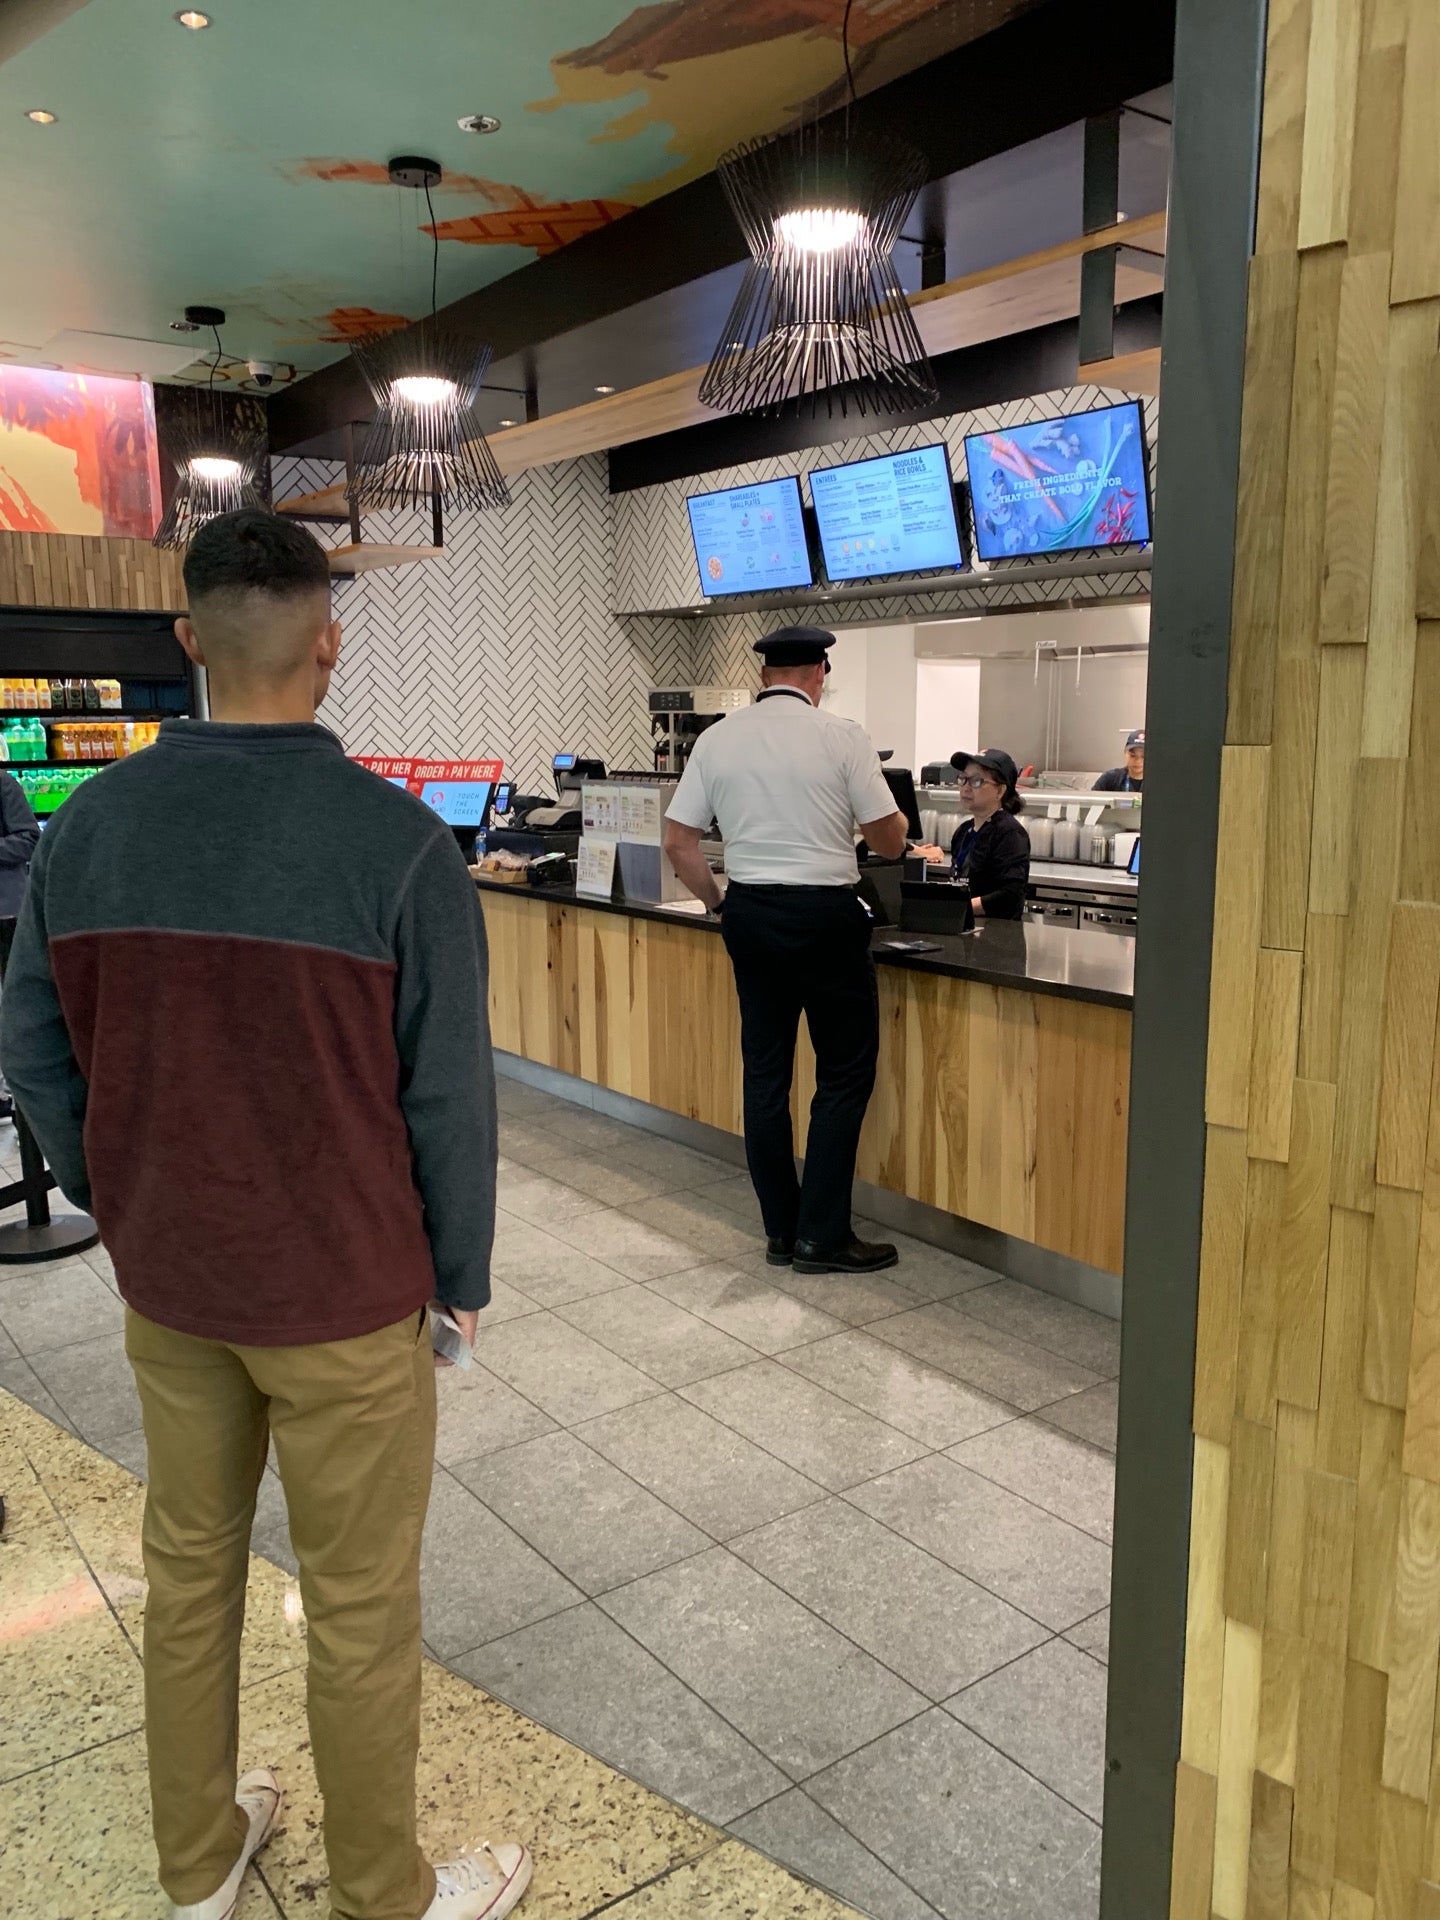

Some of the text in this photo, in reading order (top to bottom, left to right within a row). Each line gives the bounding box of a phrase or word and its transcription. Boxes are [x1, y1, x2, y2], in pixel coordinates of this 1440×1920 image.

[892, 457, 918, 469] NOODLES
[894, 463, 927, 476] RICE BOWLS
[1013, 469, 1103, 490] FRESH INGREDIENTS
[1000, 477, 1122, 504] THAT CREATE BOLD FLAVOR
[370, 761, 391, 774] PAY
[414, 765, 446, 779] ORDER
[450, 765, 470, 779] PAY
[470, 765, 497, 779] HERE
[457, 792, 480, 800] TOUCH
[455, 800, 468, 808] THE
[453, 808, 480, 816] SCREEN
